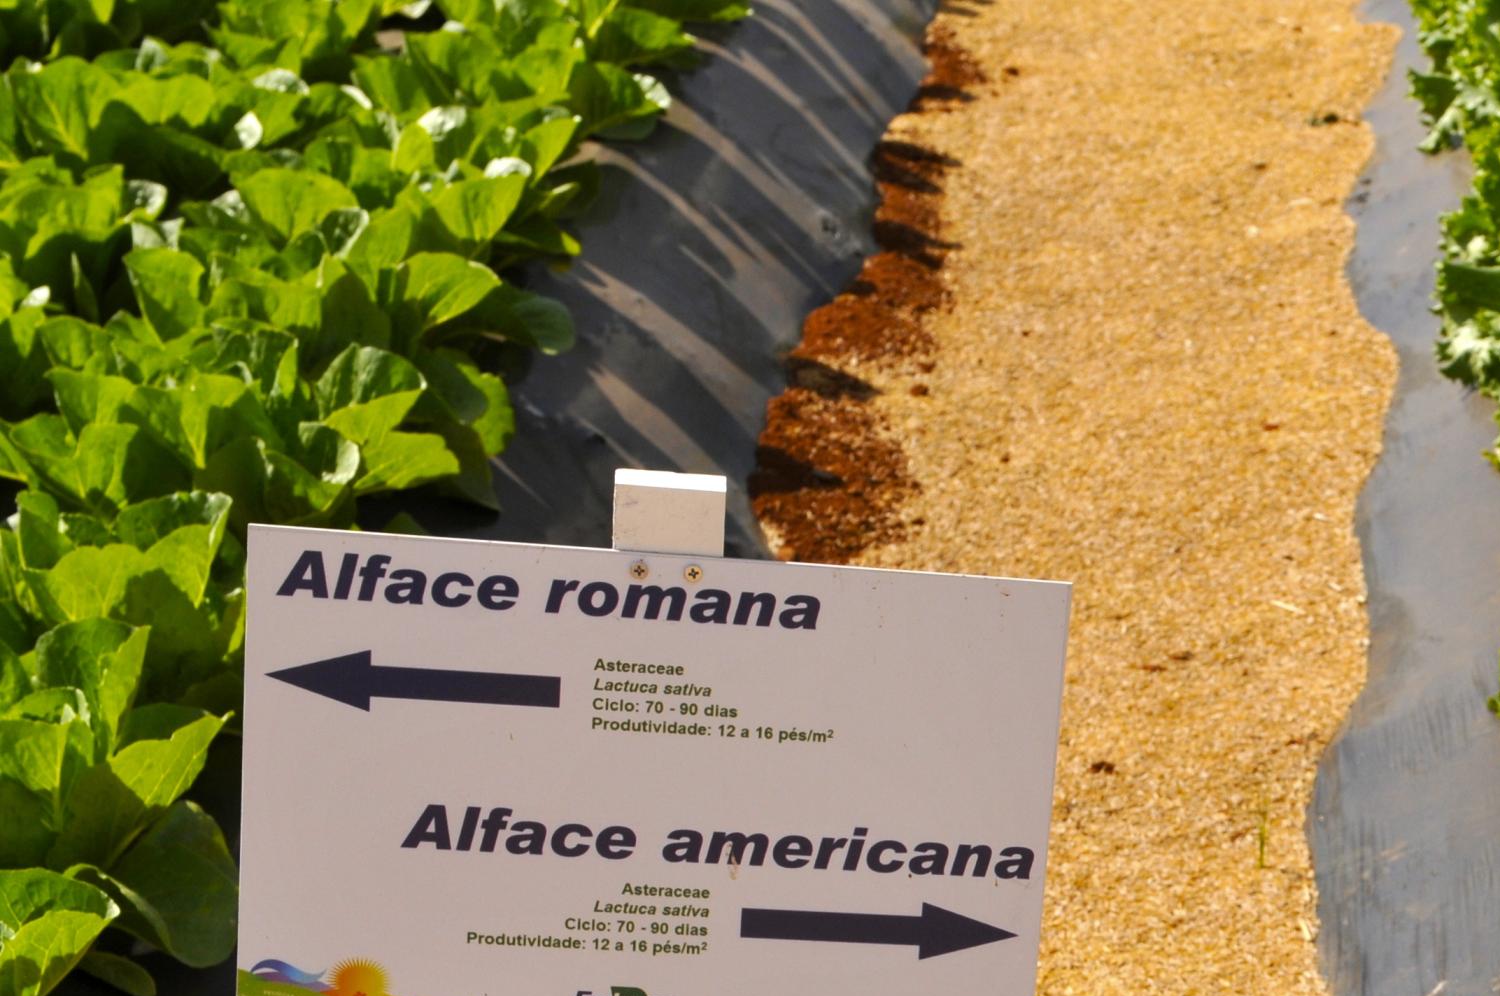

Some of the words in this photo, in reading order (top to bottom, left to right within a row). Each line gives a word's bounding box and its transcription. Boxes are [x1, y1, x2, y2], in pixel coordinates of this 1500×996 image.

[275, 549, 521, 612] Alface
[544, 578, 822, 629] romana
[593, 658, 685, 676] Asteraceae
[593, 678, 658, 694] Lactuca
[663, 682, 713, 697] sativa
[592, 697, 640, 713] Ciclo:
[644, 700, 664, 714] 70
[679, 703, 698, 716] 90
[704, 704, 738, 718] dias
[591, 717, 712, 737] Produtividade:
[718, 724, 736, 737] 12
[740, 728, 750, 739] a
[755, 726, 774, 739] 16
[401, 803, 638, 861] Alface
[661, 827, 1035, 880] americana
[621, 882, 711, 899] Asteraceae
[593, 900, 657, 915] Lactuca
[661, 904, 710, 918] sativa
[564, 918, 611, 933] Ciclo:
[616, 920, 635, 933] 70
[650, 922, 669, 935] 90
[674, 923, 708, 937] dias
[466, 931, 586, 950] Produtividade:
[592, 938, 610, 951] 12
[614, 941, 624, 951] a
[630, 940, 648, 952] 16
